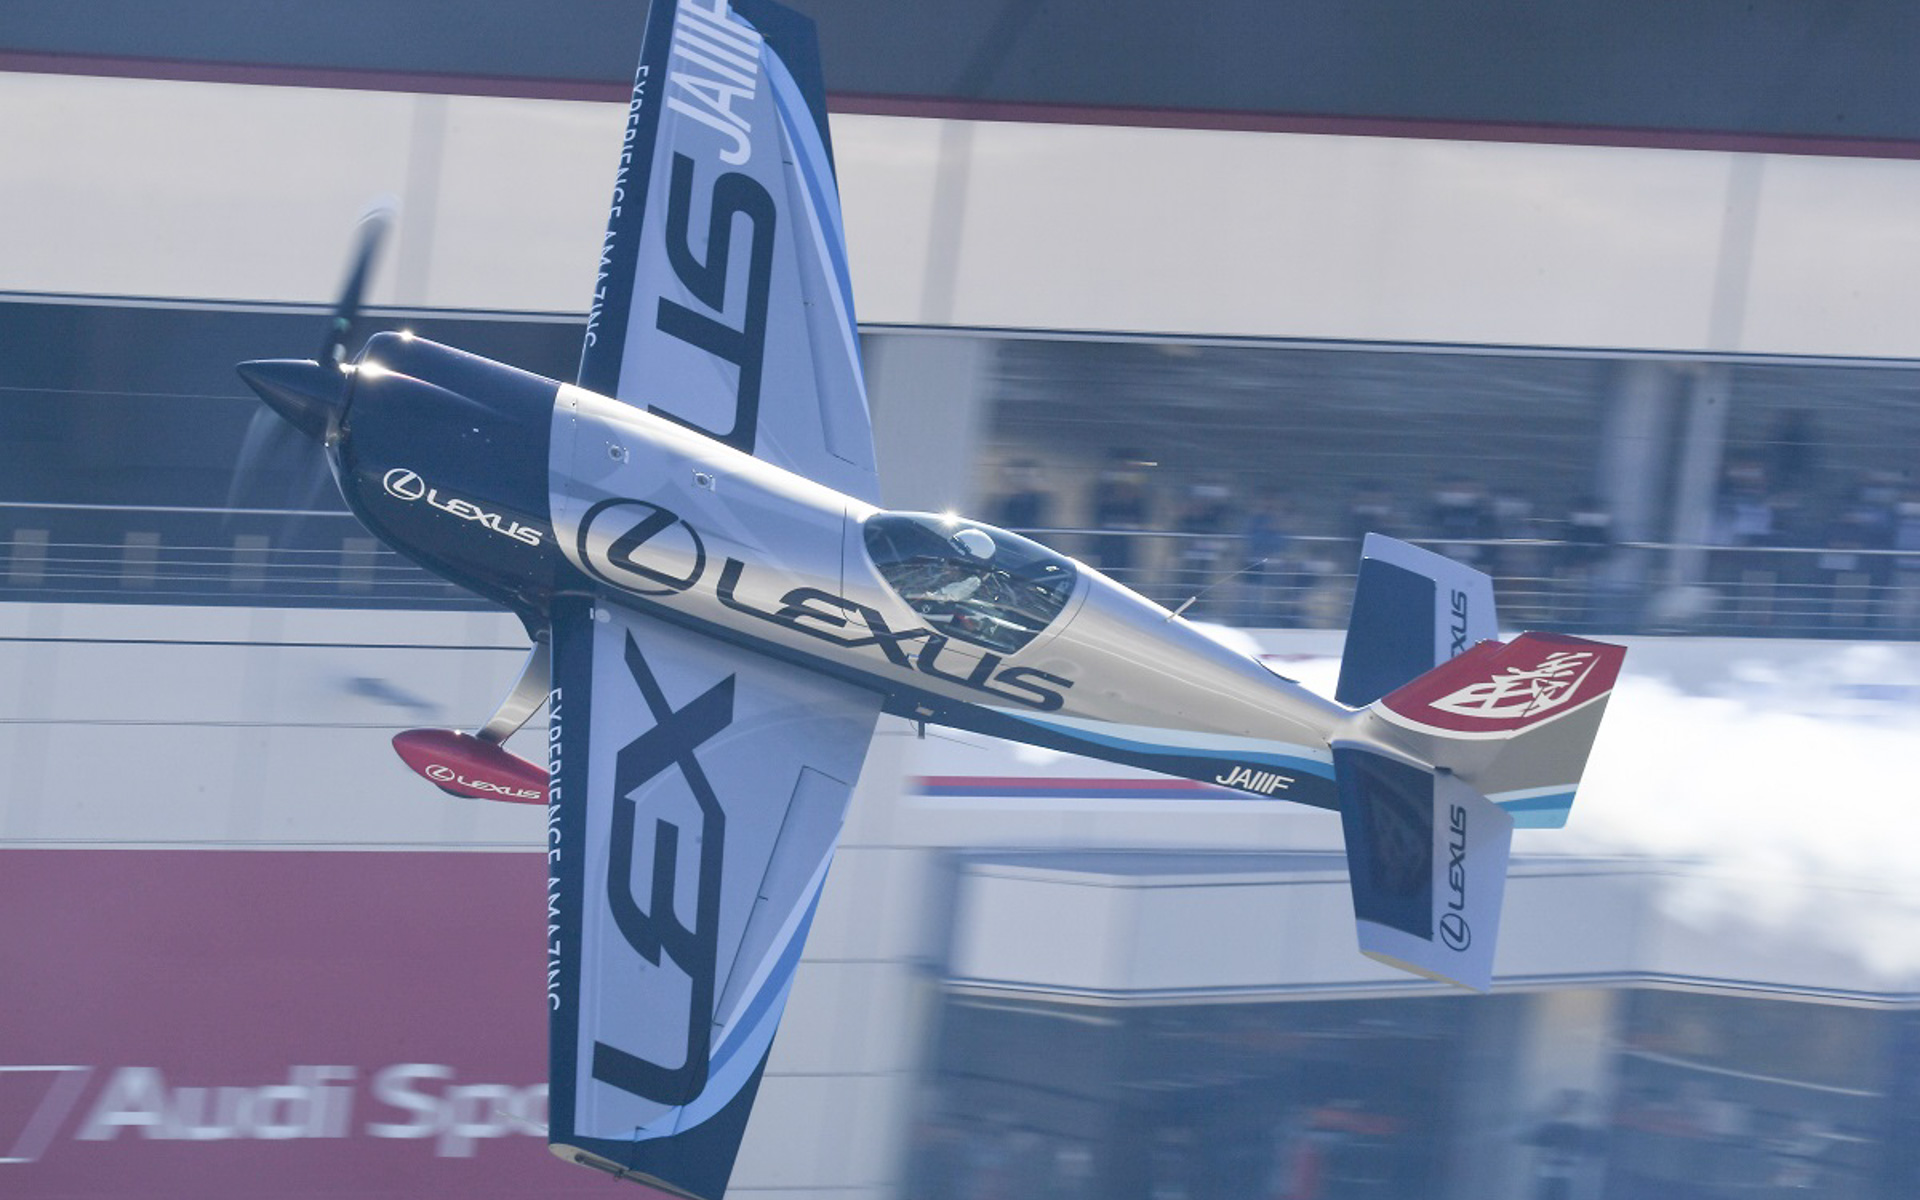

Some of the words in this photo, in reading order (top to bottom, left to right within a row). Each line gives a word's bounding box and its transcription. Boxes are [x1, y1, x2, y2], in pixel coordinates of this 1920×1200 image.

[426, 489, 543, 546] LEXUS
[716, 557, 1074, 711] LEXUS
[457, 775, 541, 799] LEXUS
[1448, 804, 1467, 911] LEXUS
[74, 1064, 357, 1141] Audi
